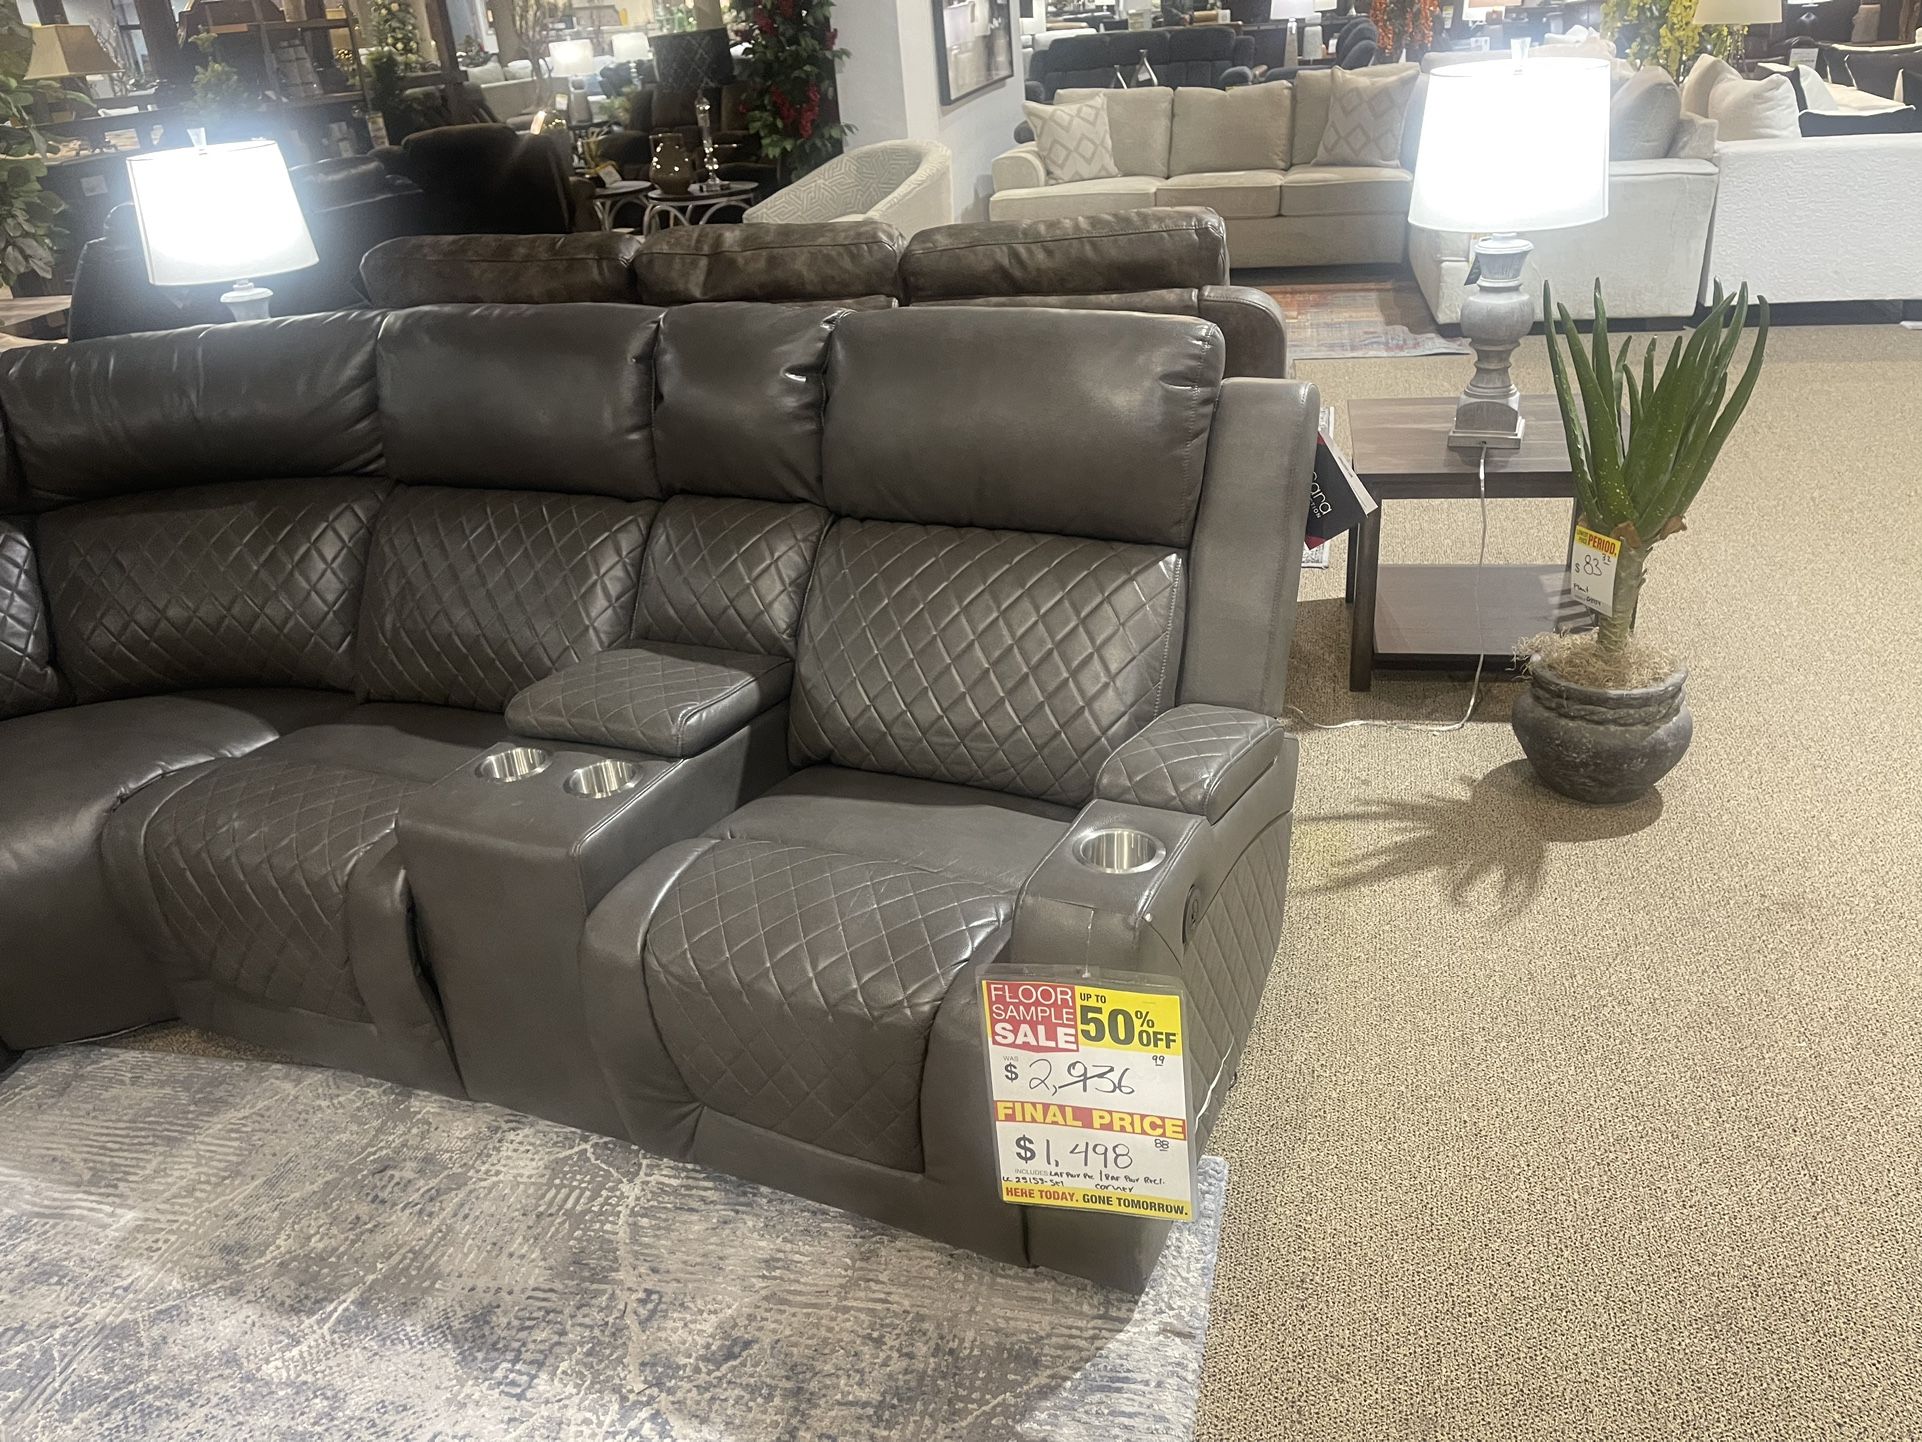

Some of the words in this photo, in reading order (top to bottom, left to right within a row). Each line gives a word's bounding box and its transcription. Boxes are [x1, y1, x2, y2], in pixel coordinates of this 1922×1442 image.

[1588, 534, 1617, 556] PERIOD.
[1584, 555, 1602, 576] 83
[990, 984, 1072, 1006] FLOOR
[1080, 992, 1092, 1002] UP
[1095, 994, 1106, 1004] TO
[992, 1004, 1075, 1025] SAMPLE
[994, 1022, 1077, 1050] SALE
[1138, 1029, 1176, 1049] OFF
[996, 1101, 1082, 1127] FINAL
[1092, 1109, 1185, 1140] PRICE
[1005, 1187, 1034, 1198] HERE
[1039, 1189, 1079, 1203] TODAY.
[1082, 1193, 1113, 1206] GONE
[1115, 1196, 1188, 1216] TOMORROW.
